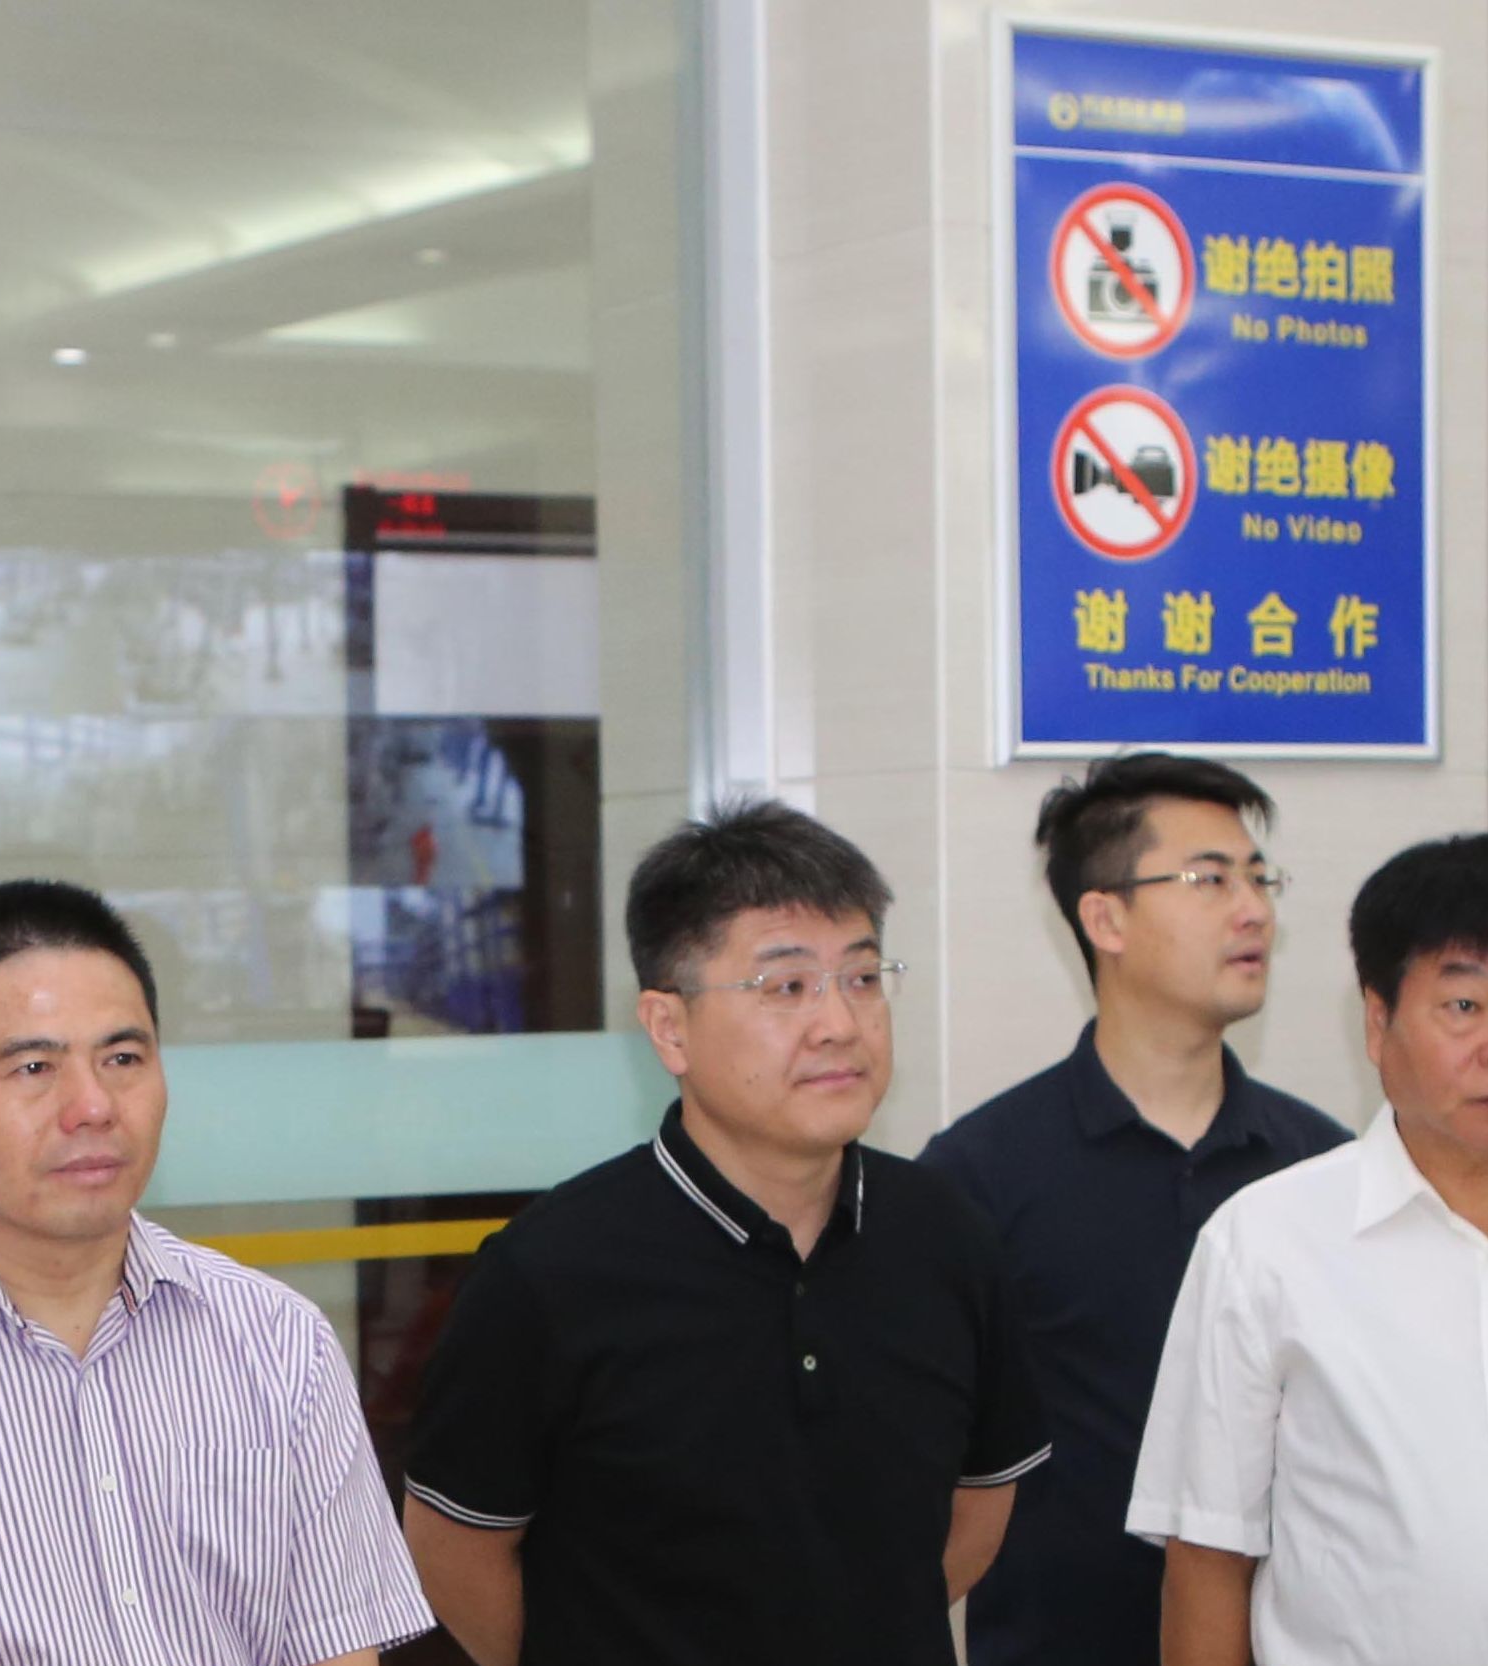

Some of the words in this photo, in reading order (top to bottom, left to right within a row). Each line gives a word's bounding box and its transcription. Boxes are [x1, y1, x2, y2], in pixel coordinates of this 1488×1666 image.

[1203, 235, 1395, 304] 谢绝拍照
[1231, 314, 1270, 341] No
[1276, 316, 1368, 347] Photos
[1204, 435, 1396, 501] 谢绝摄像
[1241, 513, 1280, 540] No
[1287, 515, 1363, 544] Video
[1074, 589, 1379, 658] 谢谢合作
[1084, 663, 1176, 691] Thanks
[1181, 664, 1223, 691] For
[1227, 665, 1371, 699] Cooperation
